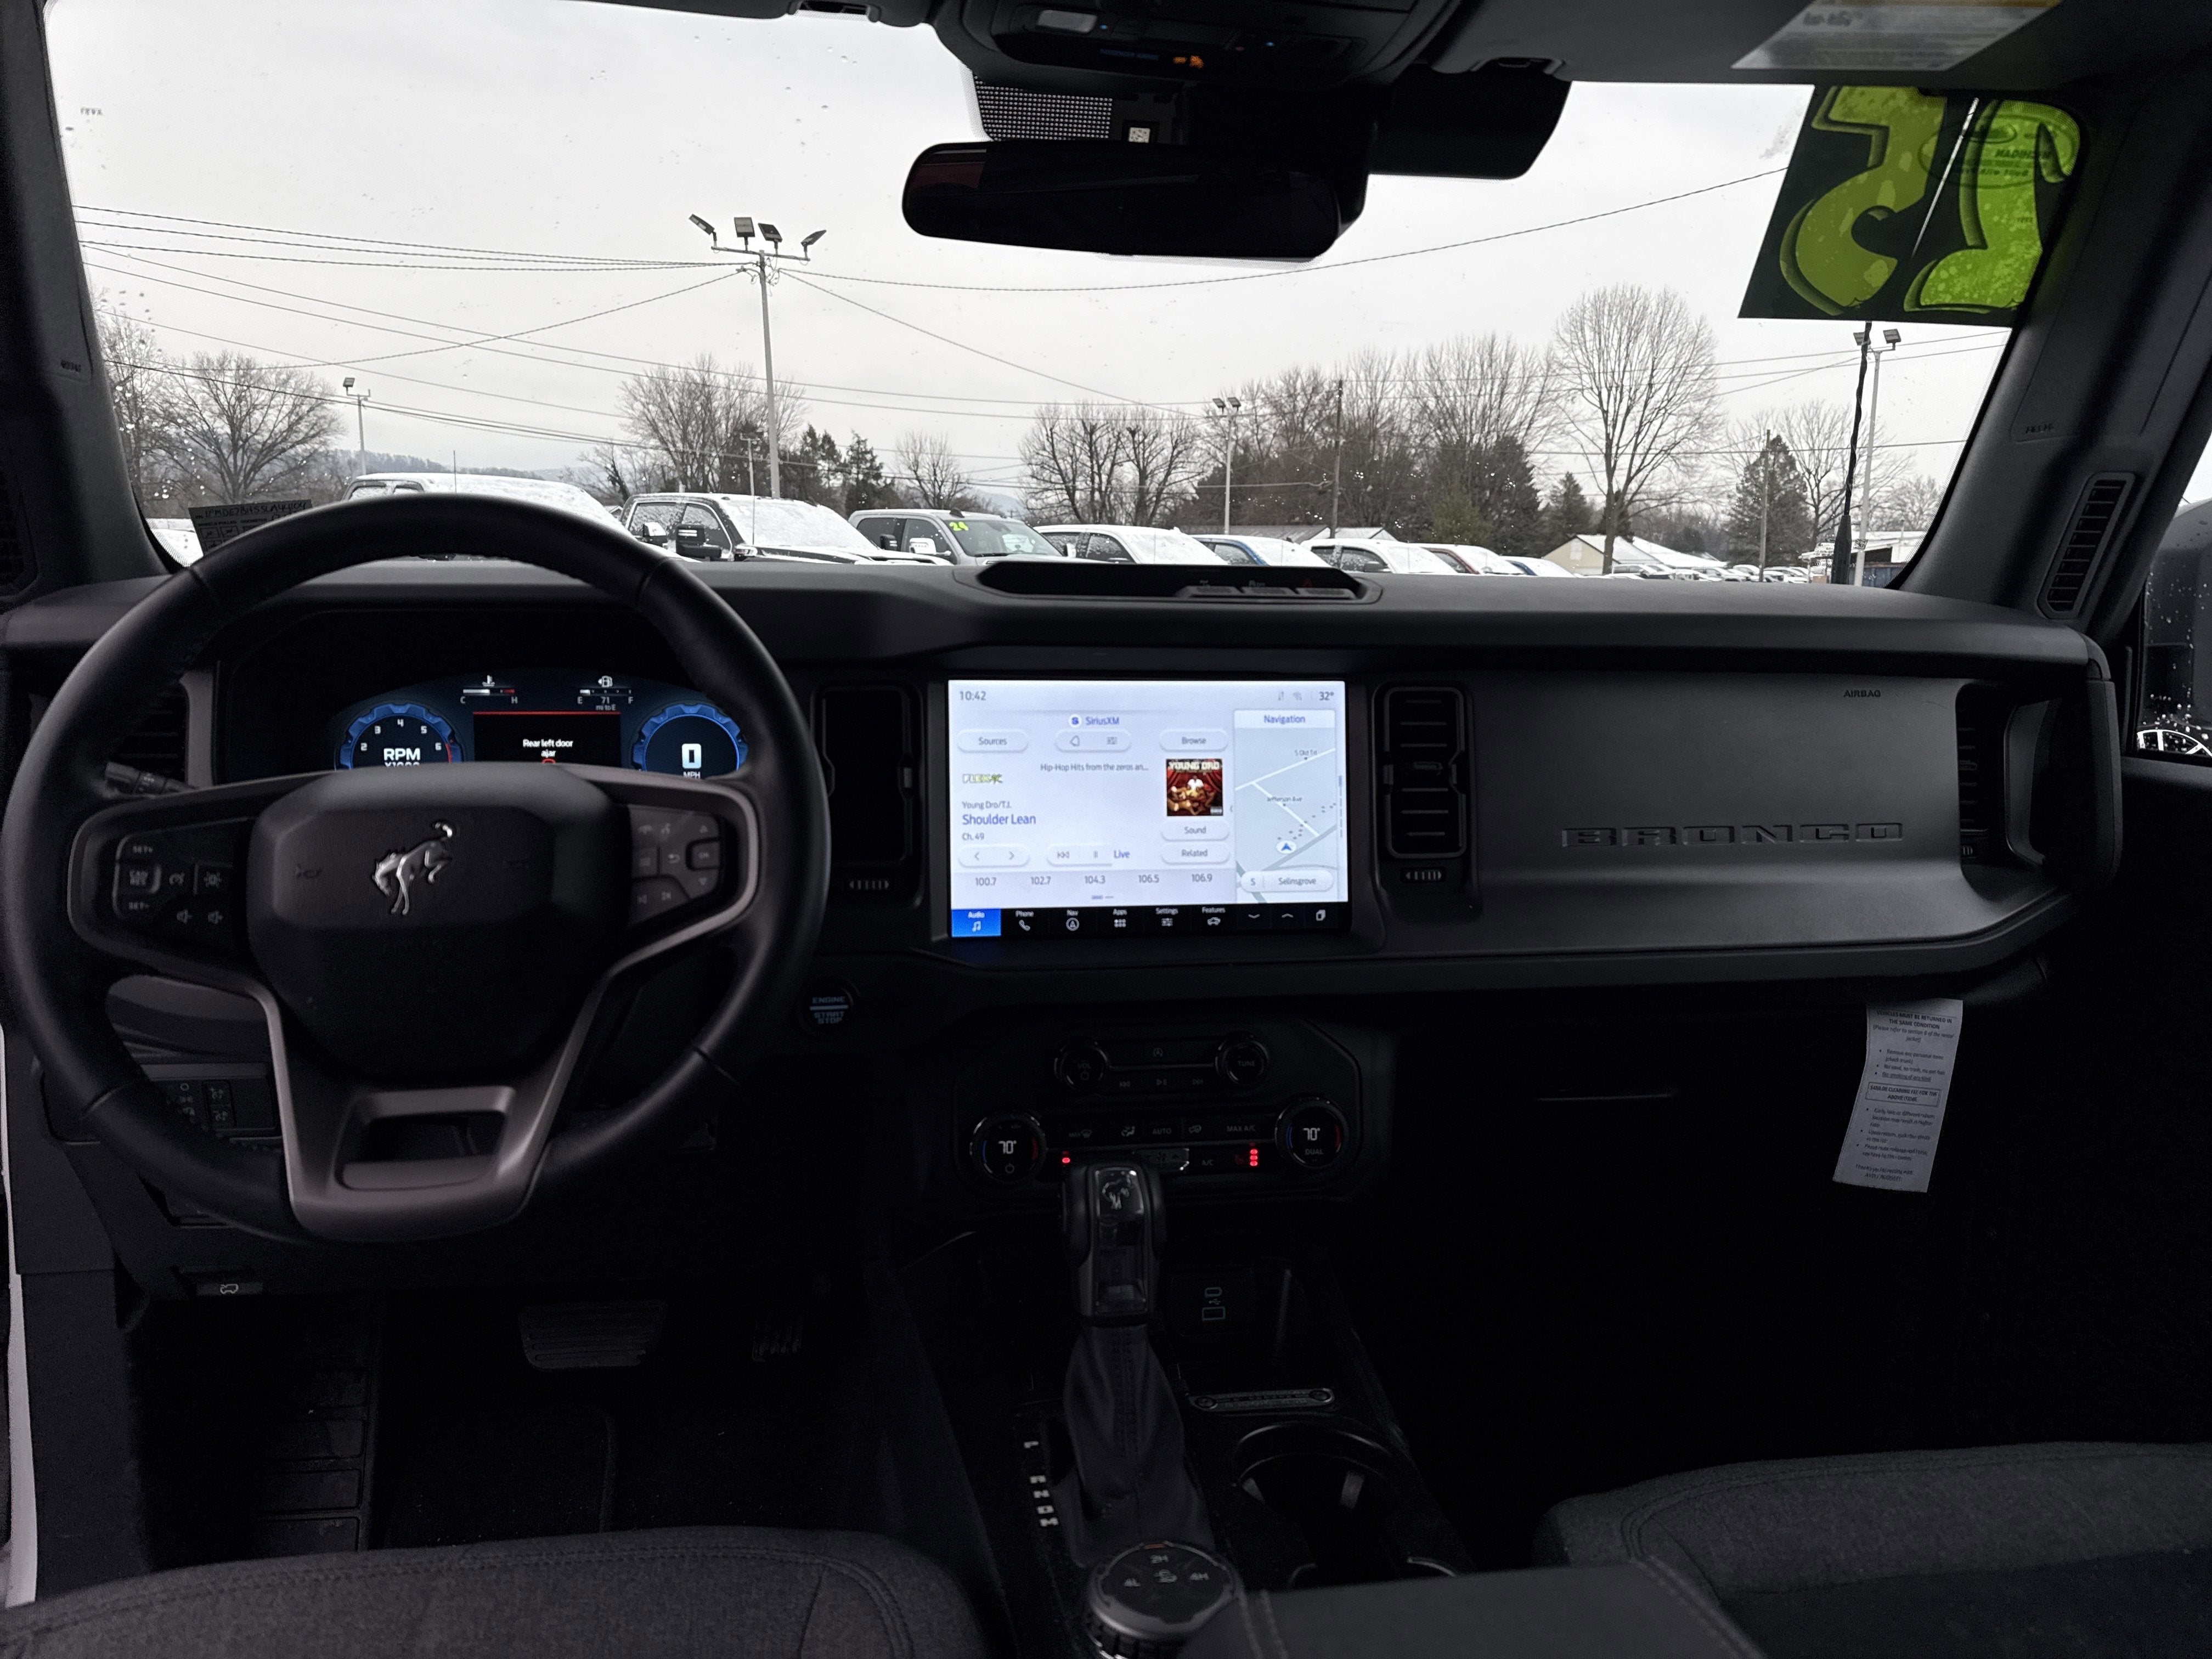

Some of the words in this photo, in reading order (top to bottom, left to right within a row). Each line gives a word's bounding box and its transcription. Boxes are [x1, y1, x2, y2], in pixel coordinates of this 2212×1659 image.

[960, 691, 986, 701] 10:42
[1319, 691, 1334, 701] 32°
[397, 719, 404, 727] 4
[1085, 715, 1120, 725] SiriusXM
[1263, 714, 1306, 724] Navigation
[375, 725, 381, 734] 3
[421, 725, 427, 734] 5
[523, 739, 540, 748] Rear
[541, 739, 555, 748] left
[556, 739, 574, 748] door
[978, 737, 1008, 746] Sources
[360, 743, 368, 751] 2
[384, 748, 421, 761] RPM
[541, 749, 556, 758] ajar
[682, 743, 702, 769] 0
[1040, 763, 1070, 772] Hip-Hop
[1071, 763, 1084, 771] Hits
[1085, 763, 1103, 771] from
[1103, 763, 1115, 771] the
[962, 801, 984, 809] Young
[962, 814, 1009, 825] Shoulder
[1011, 814, 1036, 825] Lean
[1184, 826, 1207, 834] Sound
[962, 832, 974, 840] Ch.
[975, 832, 985, 840] 49
[1561, 823, 1903, 847] BRONCO
[1114, 850, 1130, 859] Live
[975, 877, 996, 886] 100.7
[1030, 876, 1051, 885] 102.7
[1084, 875, 1106, 884] 104.3
[1138, 874, 1159, 883] 106.5
[1191, 873, 1212, 882] 106.9
